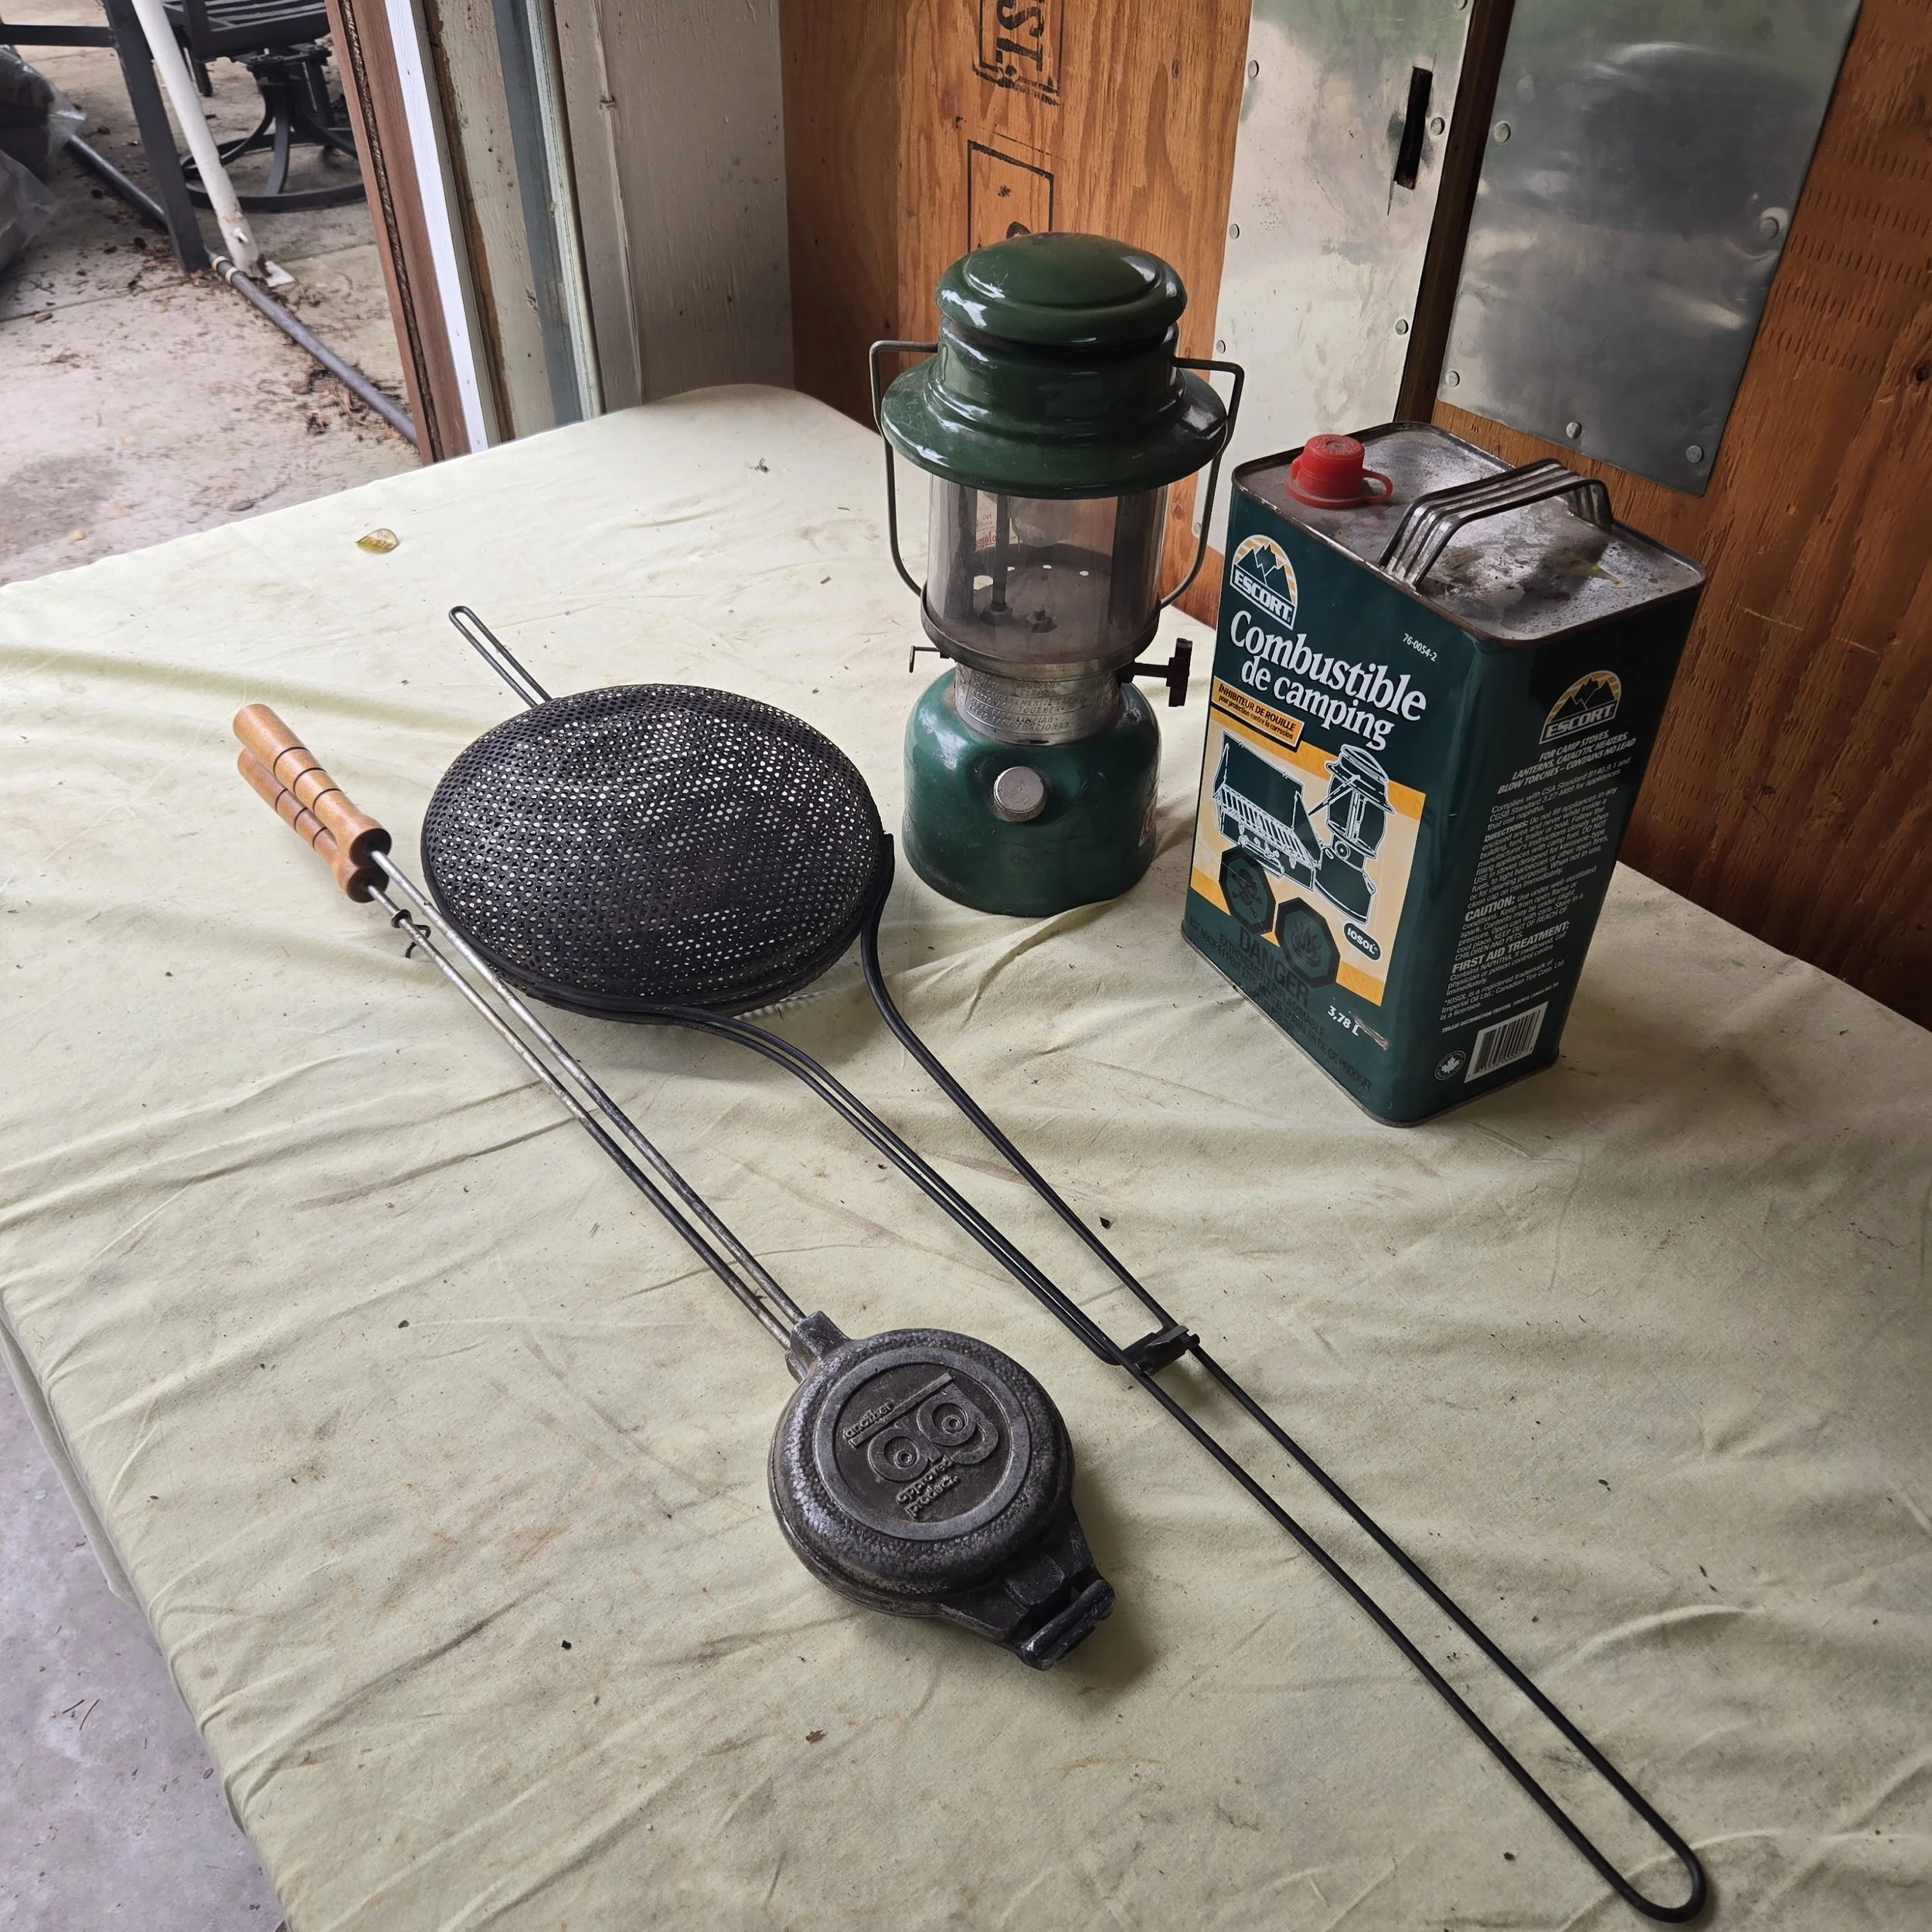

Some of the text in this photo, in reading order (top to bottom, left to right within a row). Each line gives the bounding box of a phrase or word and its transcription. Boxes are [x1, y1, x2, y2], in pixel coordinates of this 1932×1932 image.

[1233, 568, 1290, 622] ESCORT
[1403, 632, 1438, 662] 76-0054-2
[1230, 610, 1427, 722] Combustible
[1218, 682, 1295, 733] INHIBITEUR DE ROUILLE
[1240, 656, 1395, 750] de camping
[1544, 702, 1615, 739] ESCORT
[1496, 777, 1524, 795] BLOW
[1523, 764, 1560, 785] TORCHES
[1565, 749, 1604, 770] CONTAINS
[1615, 736, 1637, 752] LEAD
[1538, 748, 1556, 762] FOR
[1555, 739, 1580, 756] CAMP
[1591, 818, 1607, 831] NOT
[1473, 872, 1488, 885] USE
[1463, 893, 1516, 923] CAUTION:
[1493, 927, 1512, 940] KEEP
[1512, 922, 1526, 933] OUT
[1536, 909, 1558, 923] REACH
[1450, 920, 1570, 975] FIRST AID TREATMENT:
[1454, 943, 1489, 962] CHILDREN
[1489, 937, 1505, 949] AND
[1237, 924, 1310, 1009] DANGER
[1327, 1003, 1359, 1037] 3,78 L
